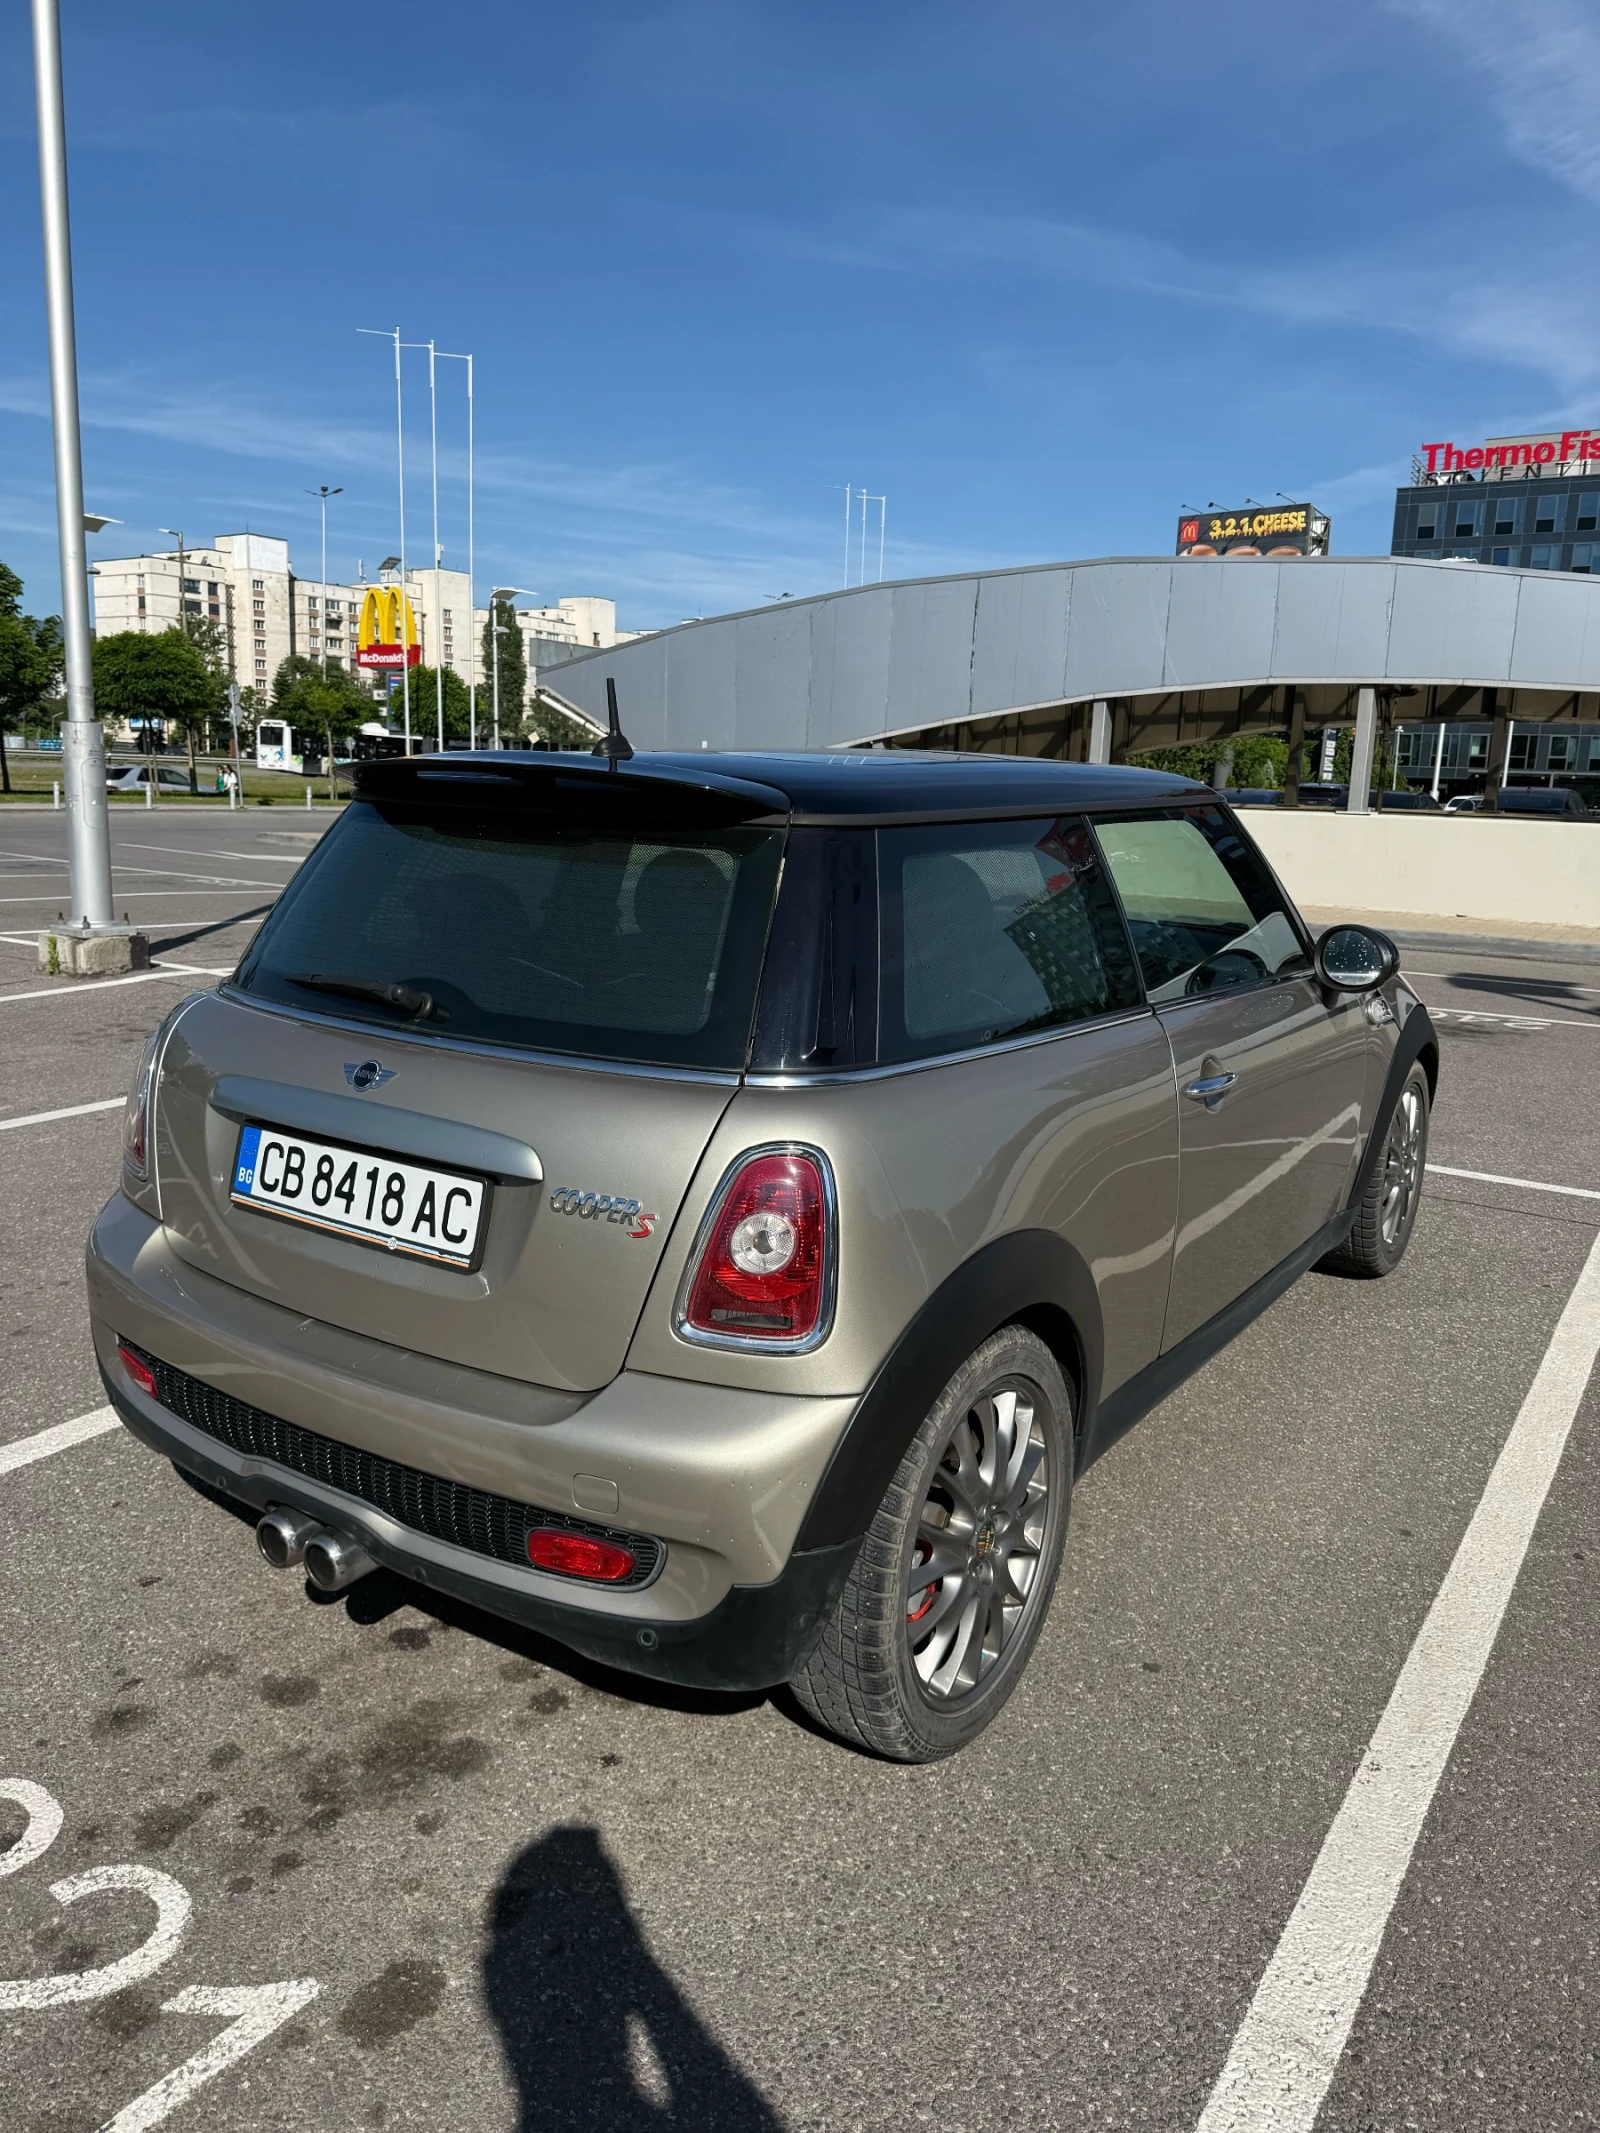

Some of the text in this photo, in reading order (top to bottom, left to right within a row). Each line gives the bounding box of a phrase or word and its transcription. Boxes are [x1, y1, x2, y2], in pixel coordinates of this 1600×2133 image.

[356, 1069, 376, 1080] MINI
[238, 1166, 253, 1185] BG
[260, 1141, 473, 1244] CB 8418 AC
[550, 1187, 660, 1238] COOPER S
